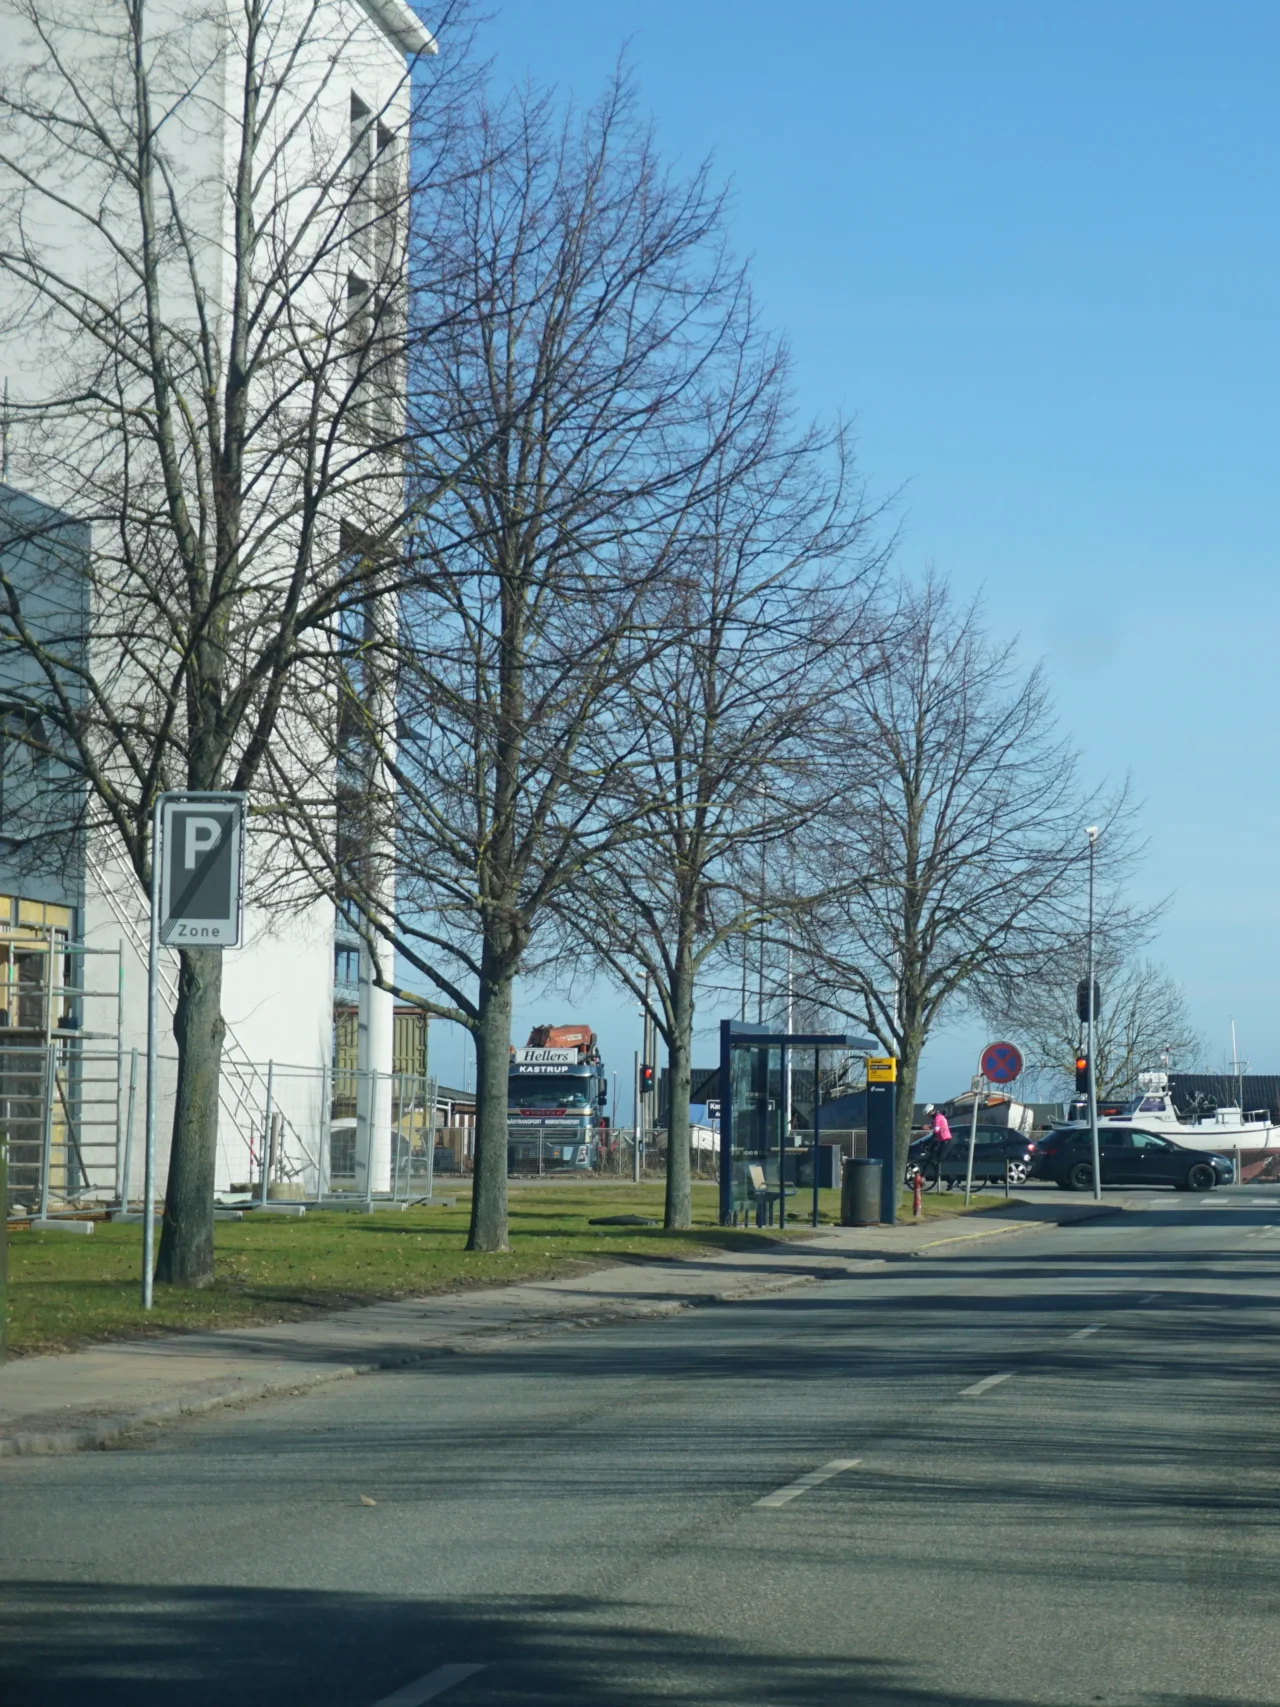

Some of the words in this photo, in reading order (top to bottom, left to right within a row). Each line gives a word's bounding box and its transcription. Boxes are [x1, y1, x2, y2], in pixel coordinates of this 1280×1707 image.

[184, 816, 222, 870] P
[178, 924, 220, 937] Zone
[524, 1050, 569, 1062] Hellers
